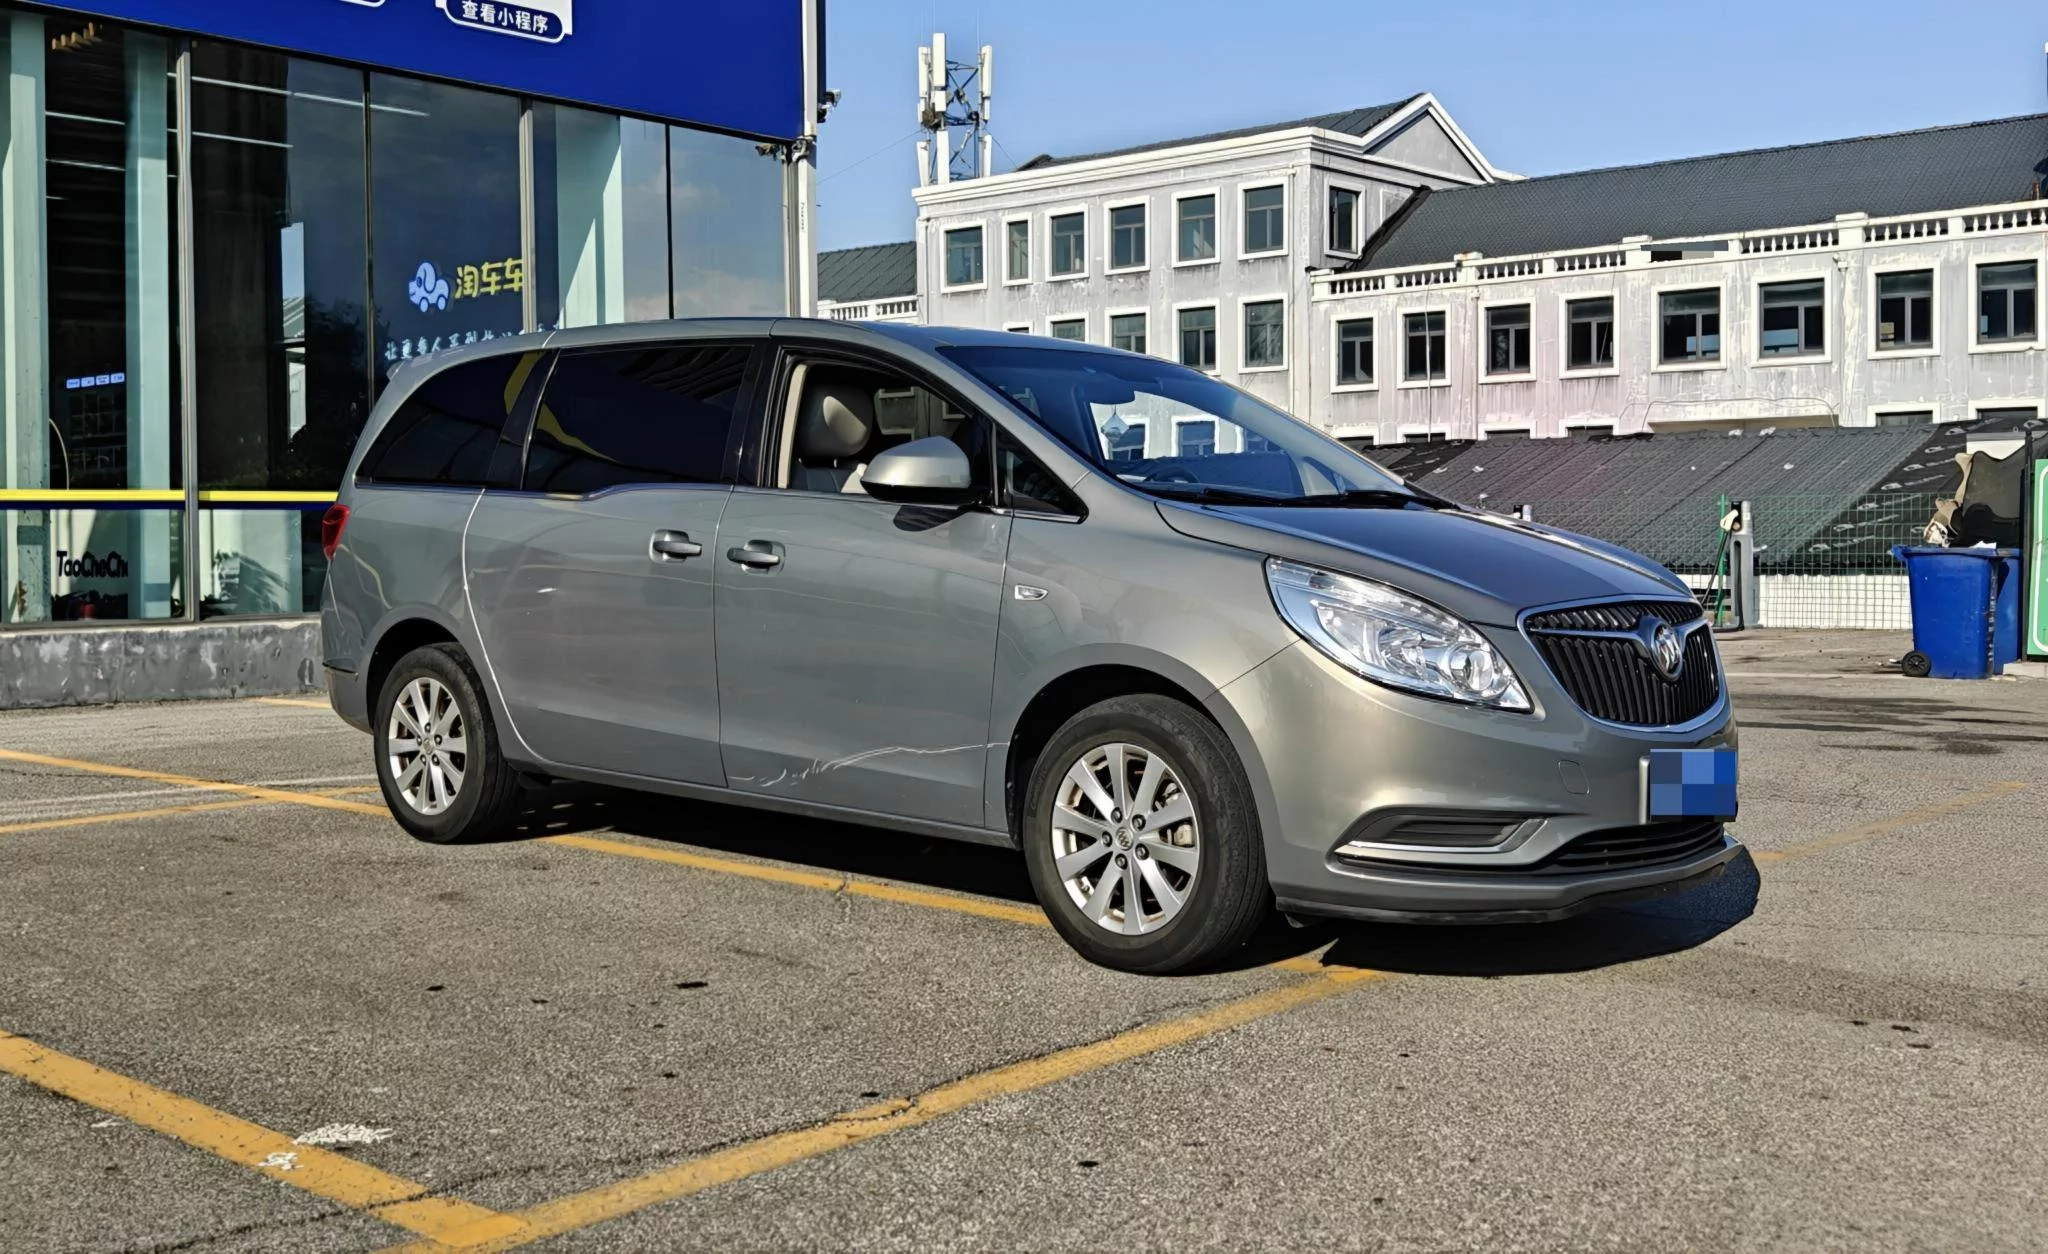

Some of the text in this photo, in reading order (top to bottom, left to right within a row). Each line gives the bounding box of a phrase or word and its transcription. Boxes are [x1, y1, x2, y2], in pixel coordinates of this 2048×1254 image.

[461, 1, 548, 34] 查看小程序
[454, 257, 523, 299] 淘车车
